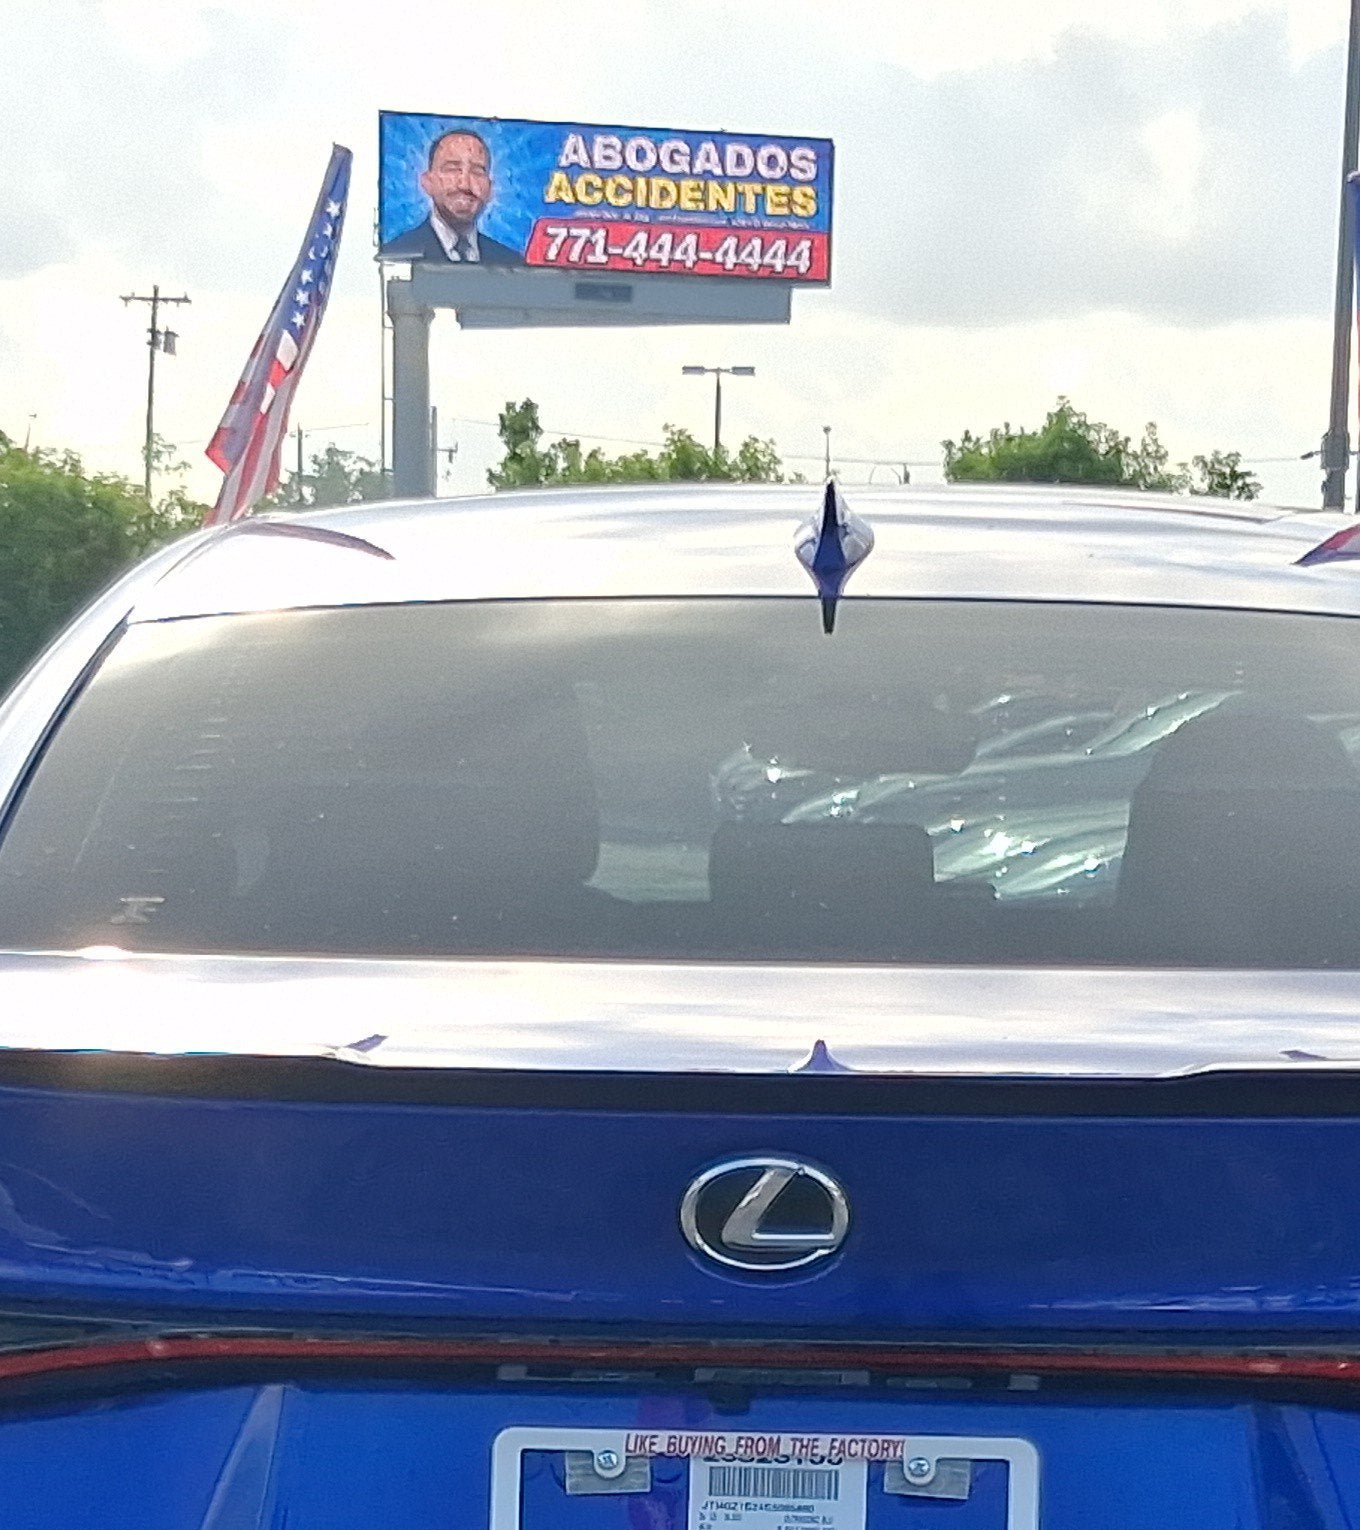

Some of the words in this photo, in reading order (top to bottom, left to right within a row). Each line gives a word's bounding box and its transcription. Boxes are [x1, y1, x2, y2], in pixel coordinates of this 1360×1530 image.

[558, 132, 818, 181] ABOGADOS
[544, 171, 819, 218] ACCIDENTES
[544, 226, 813, 274] 771-444-4444
[625, 1432, 659, 1454] LIKE
[666, 1434, 726, 1456] BUYING
[735, 1435, 782, 1457] FROM
[790, 1437, 820, 1458] THE
